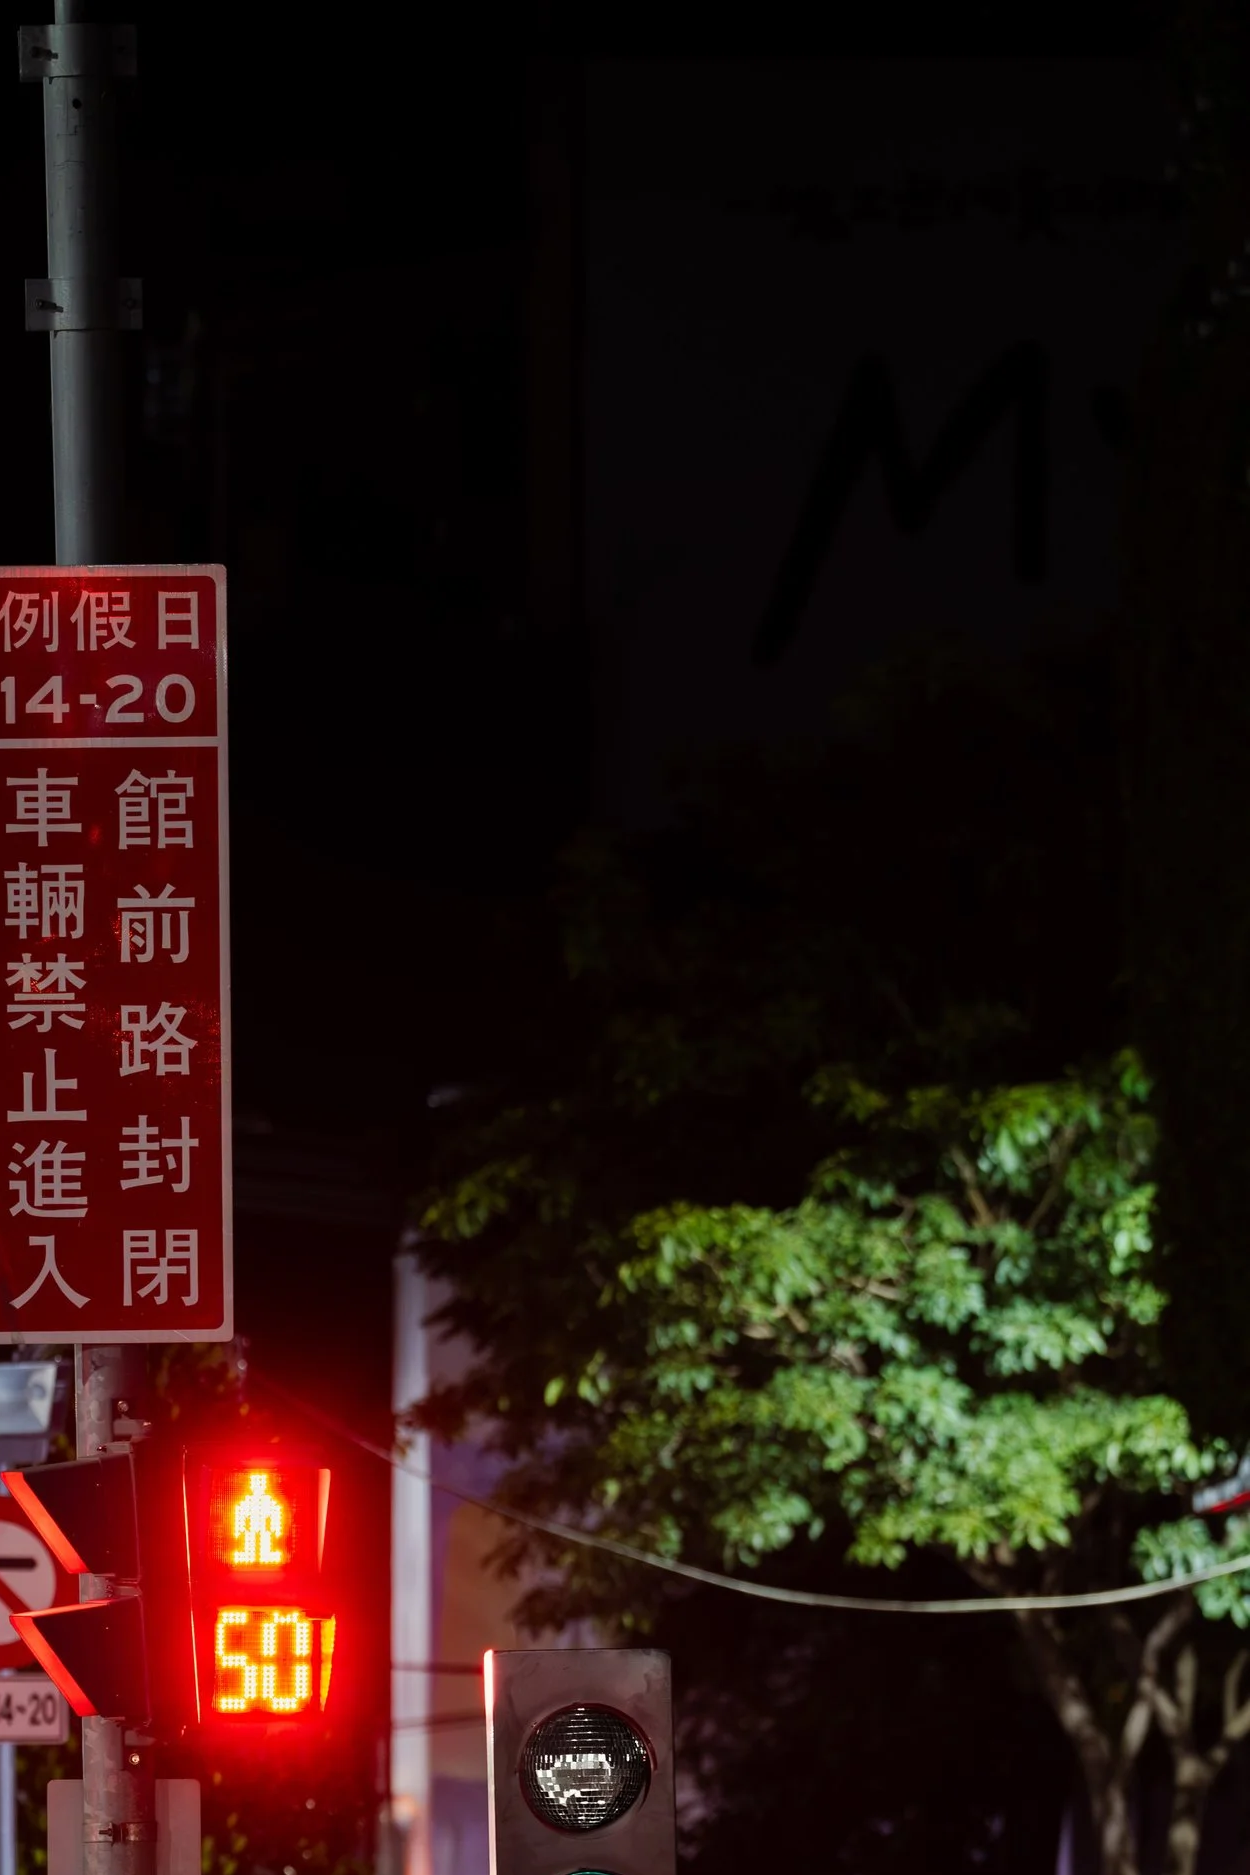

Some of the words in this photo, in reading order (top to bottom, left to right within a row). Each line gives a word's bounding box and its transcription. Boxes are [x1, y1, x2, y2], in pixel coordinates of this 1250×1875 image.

[0, 673, 196, 724] 14-20
[3, 767, 92, 1309] 車輛禁止進入
[114, 768, 200, 1307] 館前路封閉
[215, 1611, 310, 1711] 50
